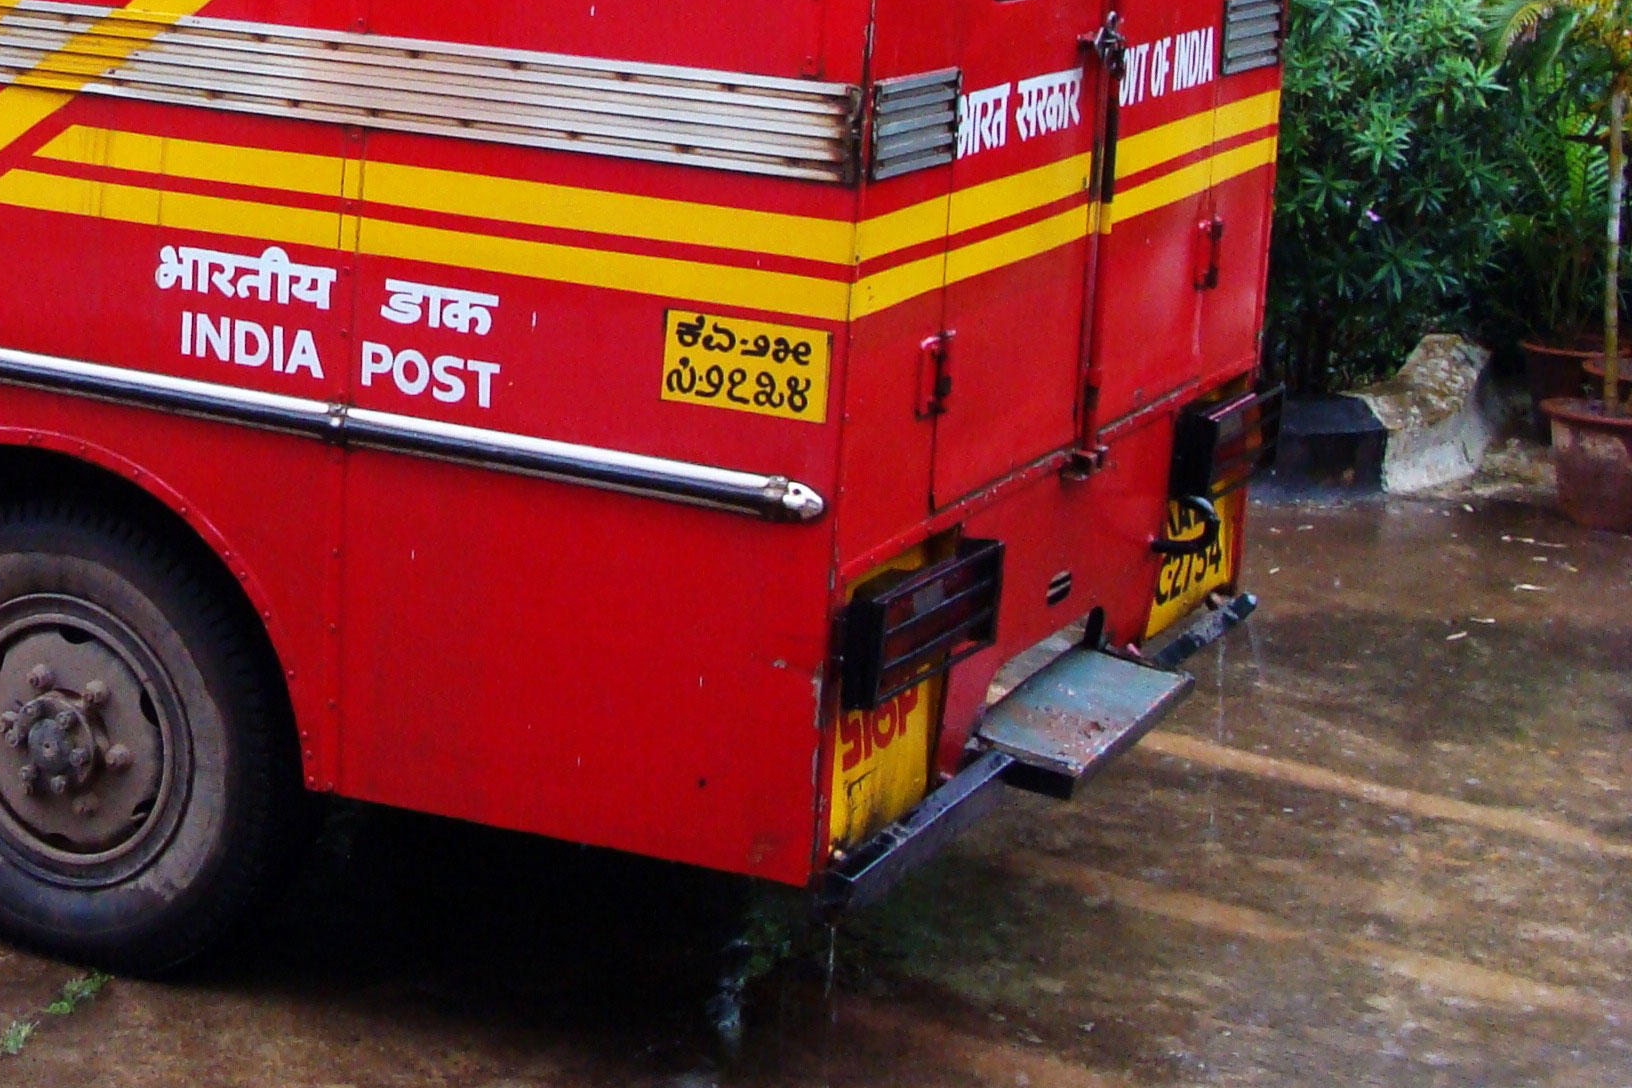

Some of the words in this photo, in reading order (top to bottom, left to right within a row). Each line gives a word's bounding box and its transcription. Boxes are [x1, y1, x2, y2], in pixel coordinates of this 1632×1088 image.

[1016, 68, 1083, 141] सरकार
[1118, 42, 1150, 107] OVT
[1151, 36, 1172, 98] OF
[1173, 25, 1214, 92] INDIA
[155, 245, 337, 309] भारतीय
[381, 278, 499, 335] डाक
[180, 311, 325, 379] INDIA
[361, 341, 501, 408] POST
